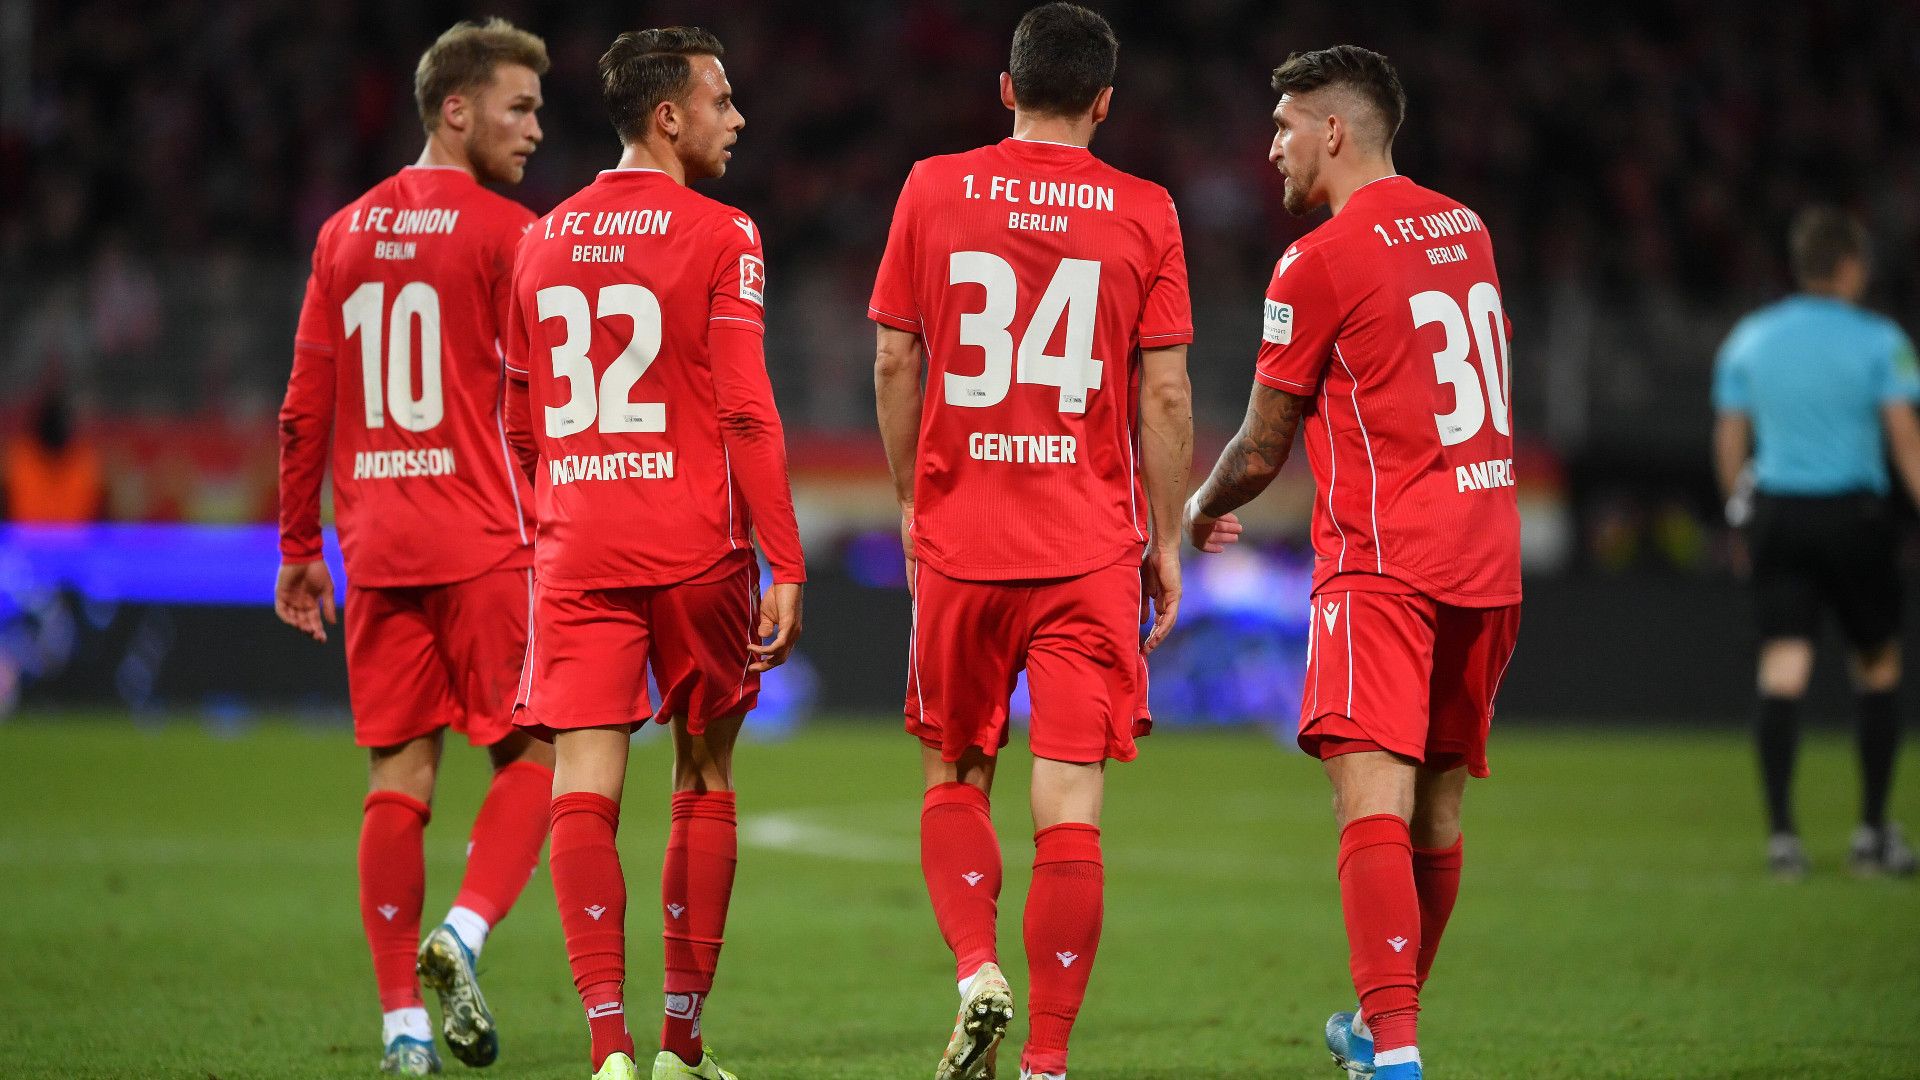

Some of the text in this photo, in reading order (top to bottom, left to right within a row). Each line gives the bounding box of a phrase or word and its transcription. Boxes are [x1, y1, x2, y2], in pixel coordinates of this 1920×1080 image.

[963, 175, 1114, 211] 1. FC UNION
[365, 207, 393, 233] FC
[392, 208, 459, 235] UNION
[544, 210, 672, 240] 1. FC UNION
[1008, 212, 1068, 233] BERLIN
[1374, 207, 1482, 247] 1. FC UNION
[572, 245, 625, 263] BERLIN
[1426, 244, 1468, 265] BERLIN
[944, 250, 1104, 414] 34
[342, 281, 444, 433] 10
[536, 284, 666, 438] 32
[1408, 281, 1510, 447] 30
[353, 447, 456, 480] ANDRSSON
[969, 432, 1077, 464] GENTNER
